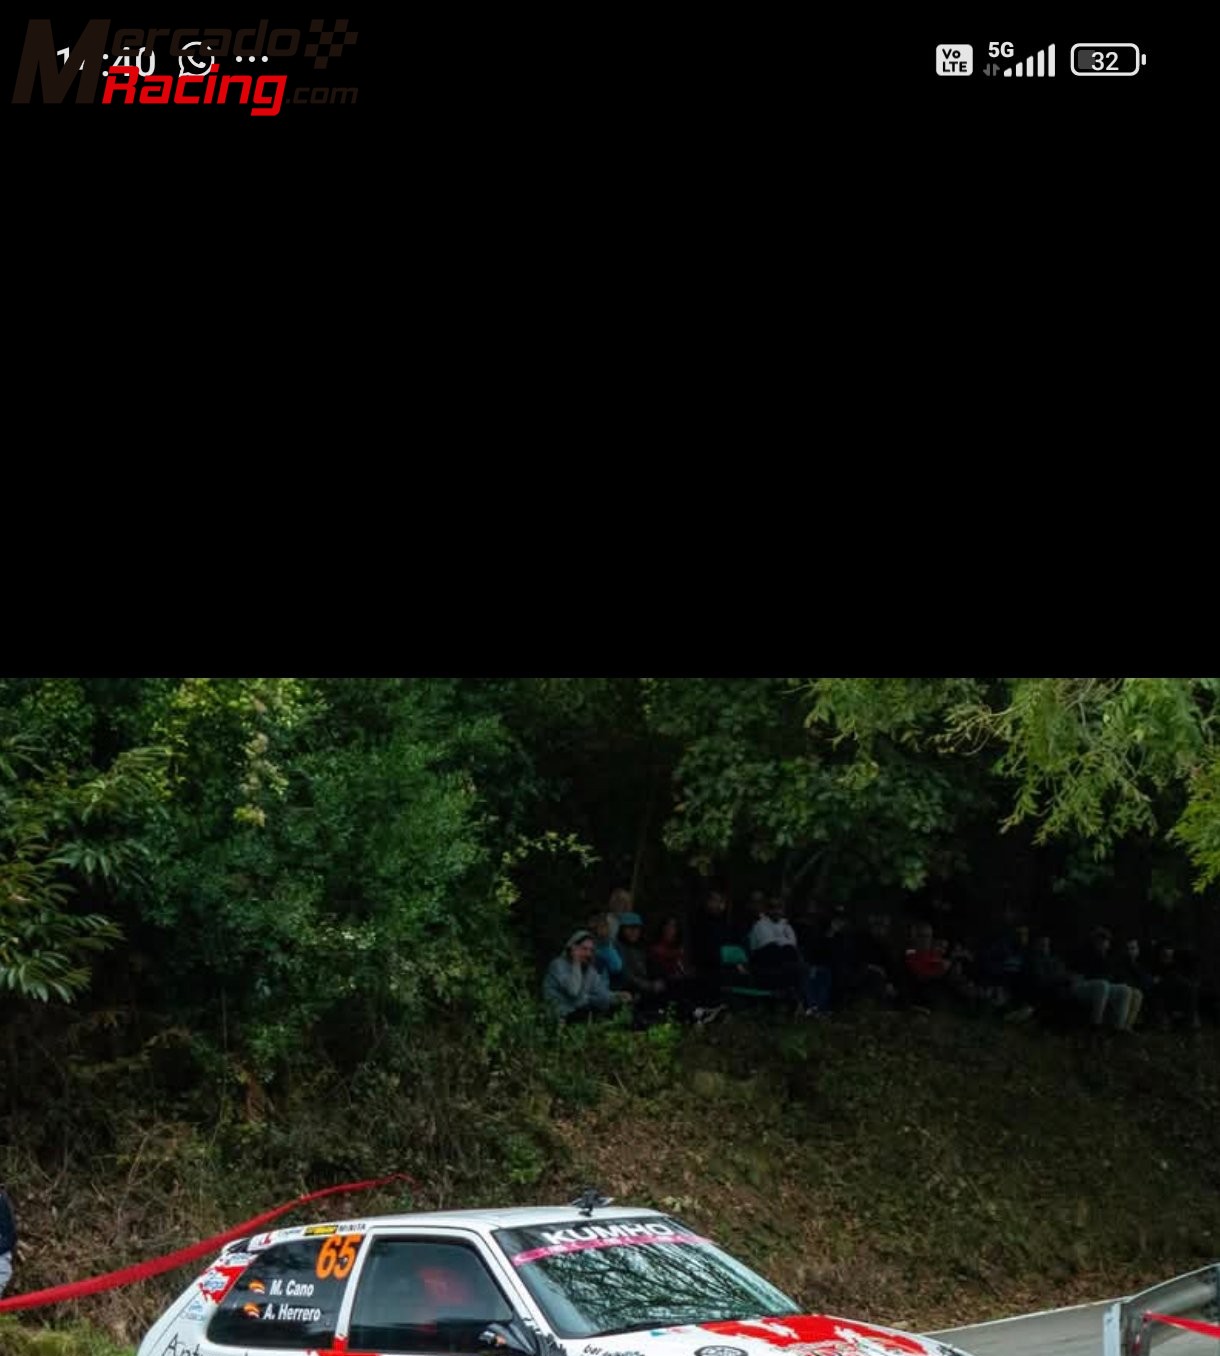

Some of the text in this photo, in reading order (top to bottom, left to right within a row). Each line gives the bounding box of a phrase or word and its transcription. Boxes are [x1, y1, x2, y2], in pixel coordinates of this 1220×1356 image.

[541, 1223, 674, 1245] KUMHO
[315, 1233, 363, 1280] 65
[270, 1279, 315, 1297] M. Cano
[263, 1303, 321, 1322] A. Herrero
